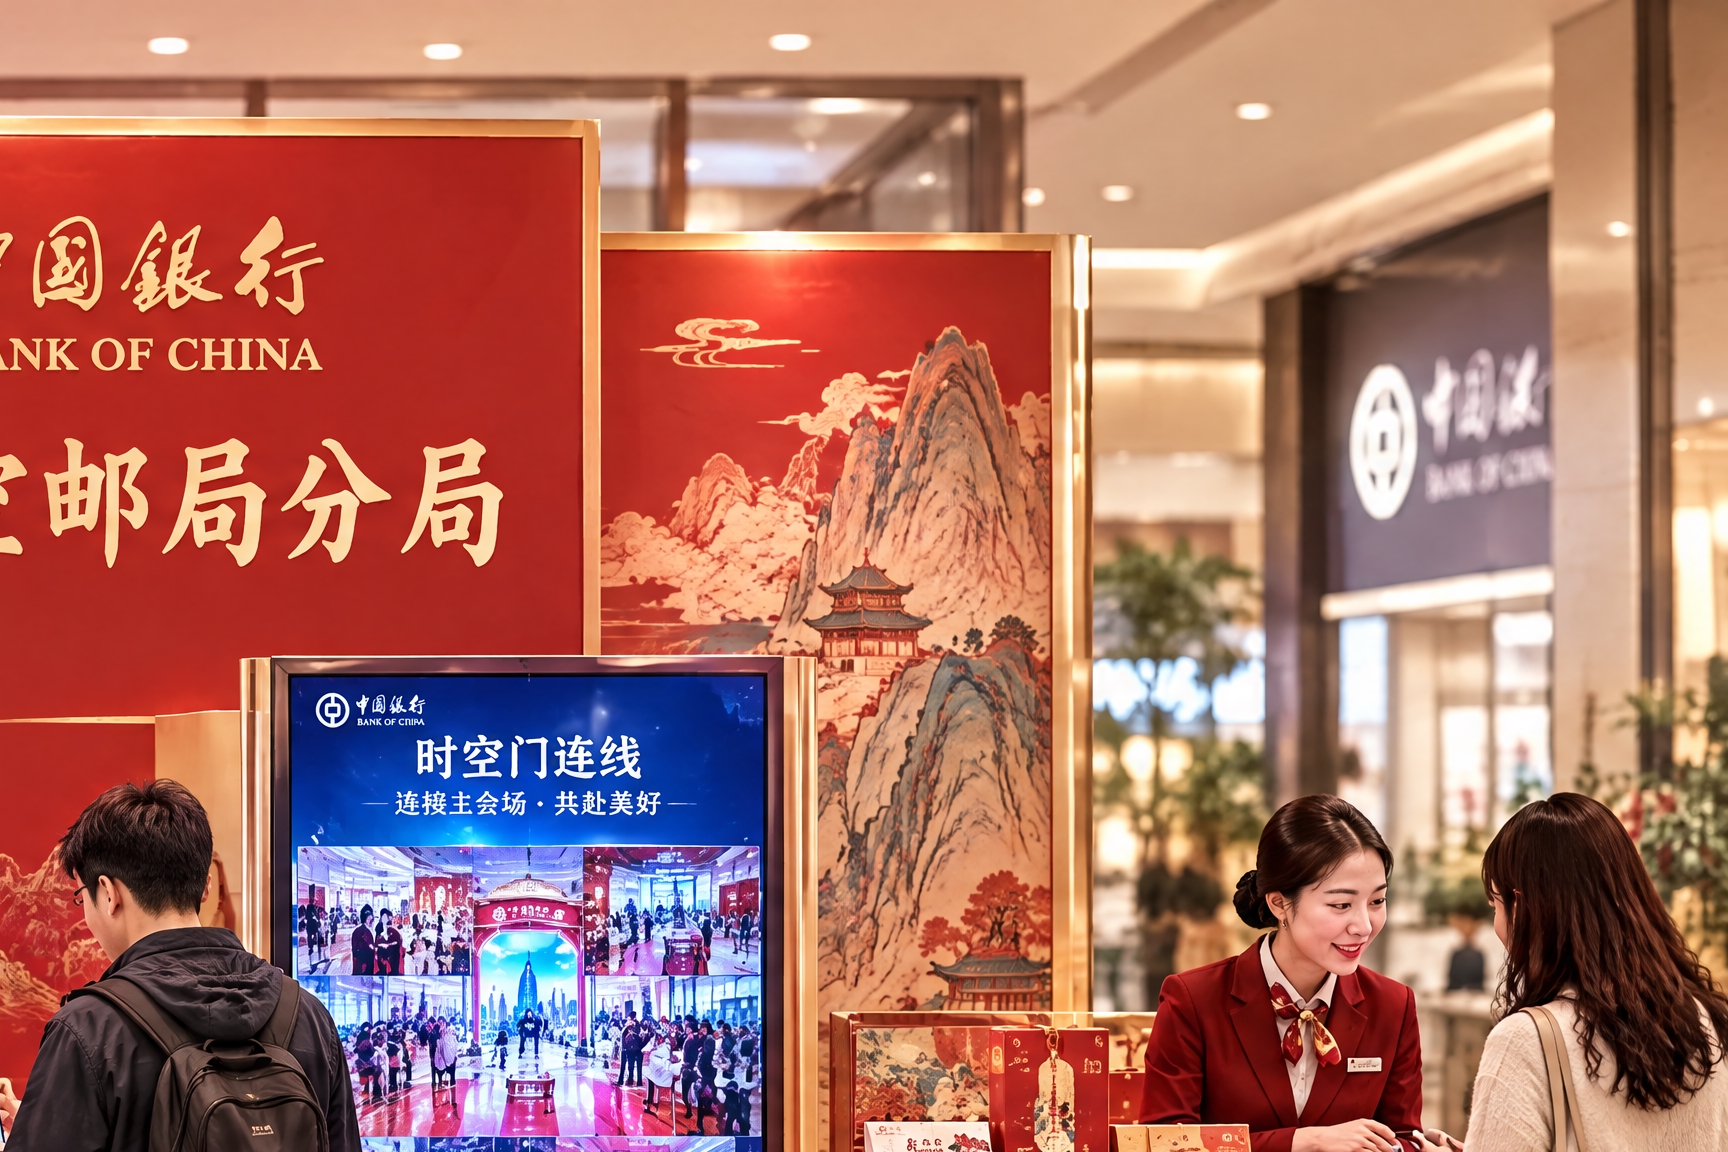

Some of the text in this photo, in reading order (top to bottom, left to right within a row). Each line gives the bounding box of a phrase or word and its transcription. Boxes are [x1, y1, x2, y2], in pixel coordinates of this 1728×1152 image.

[92, 338, 153, 371] OF
[168, 338, 323, 371] CHINA
[357, 717, 382, 726] BANK
[383, 718, 397, 726] OF
[416, 734, 642, 780] 时空门连线
